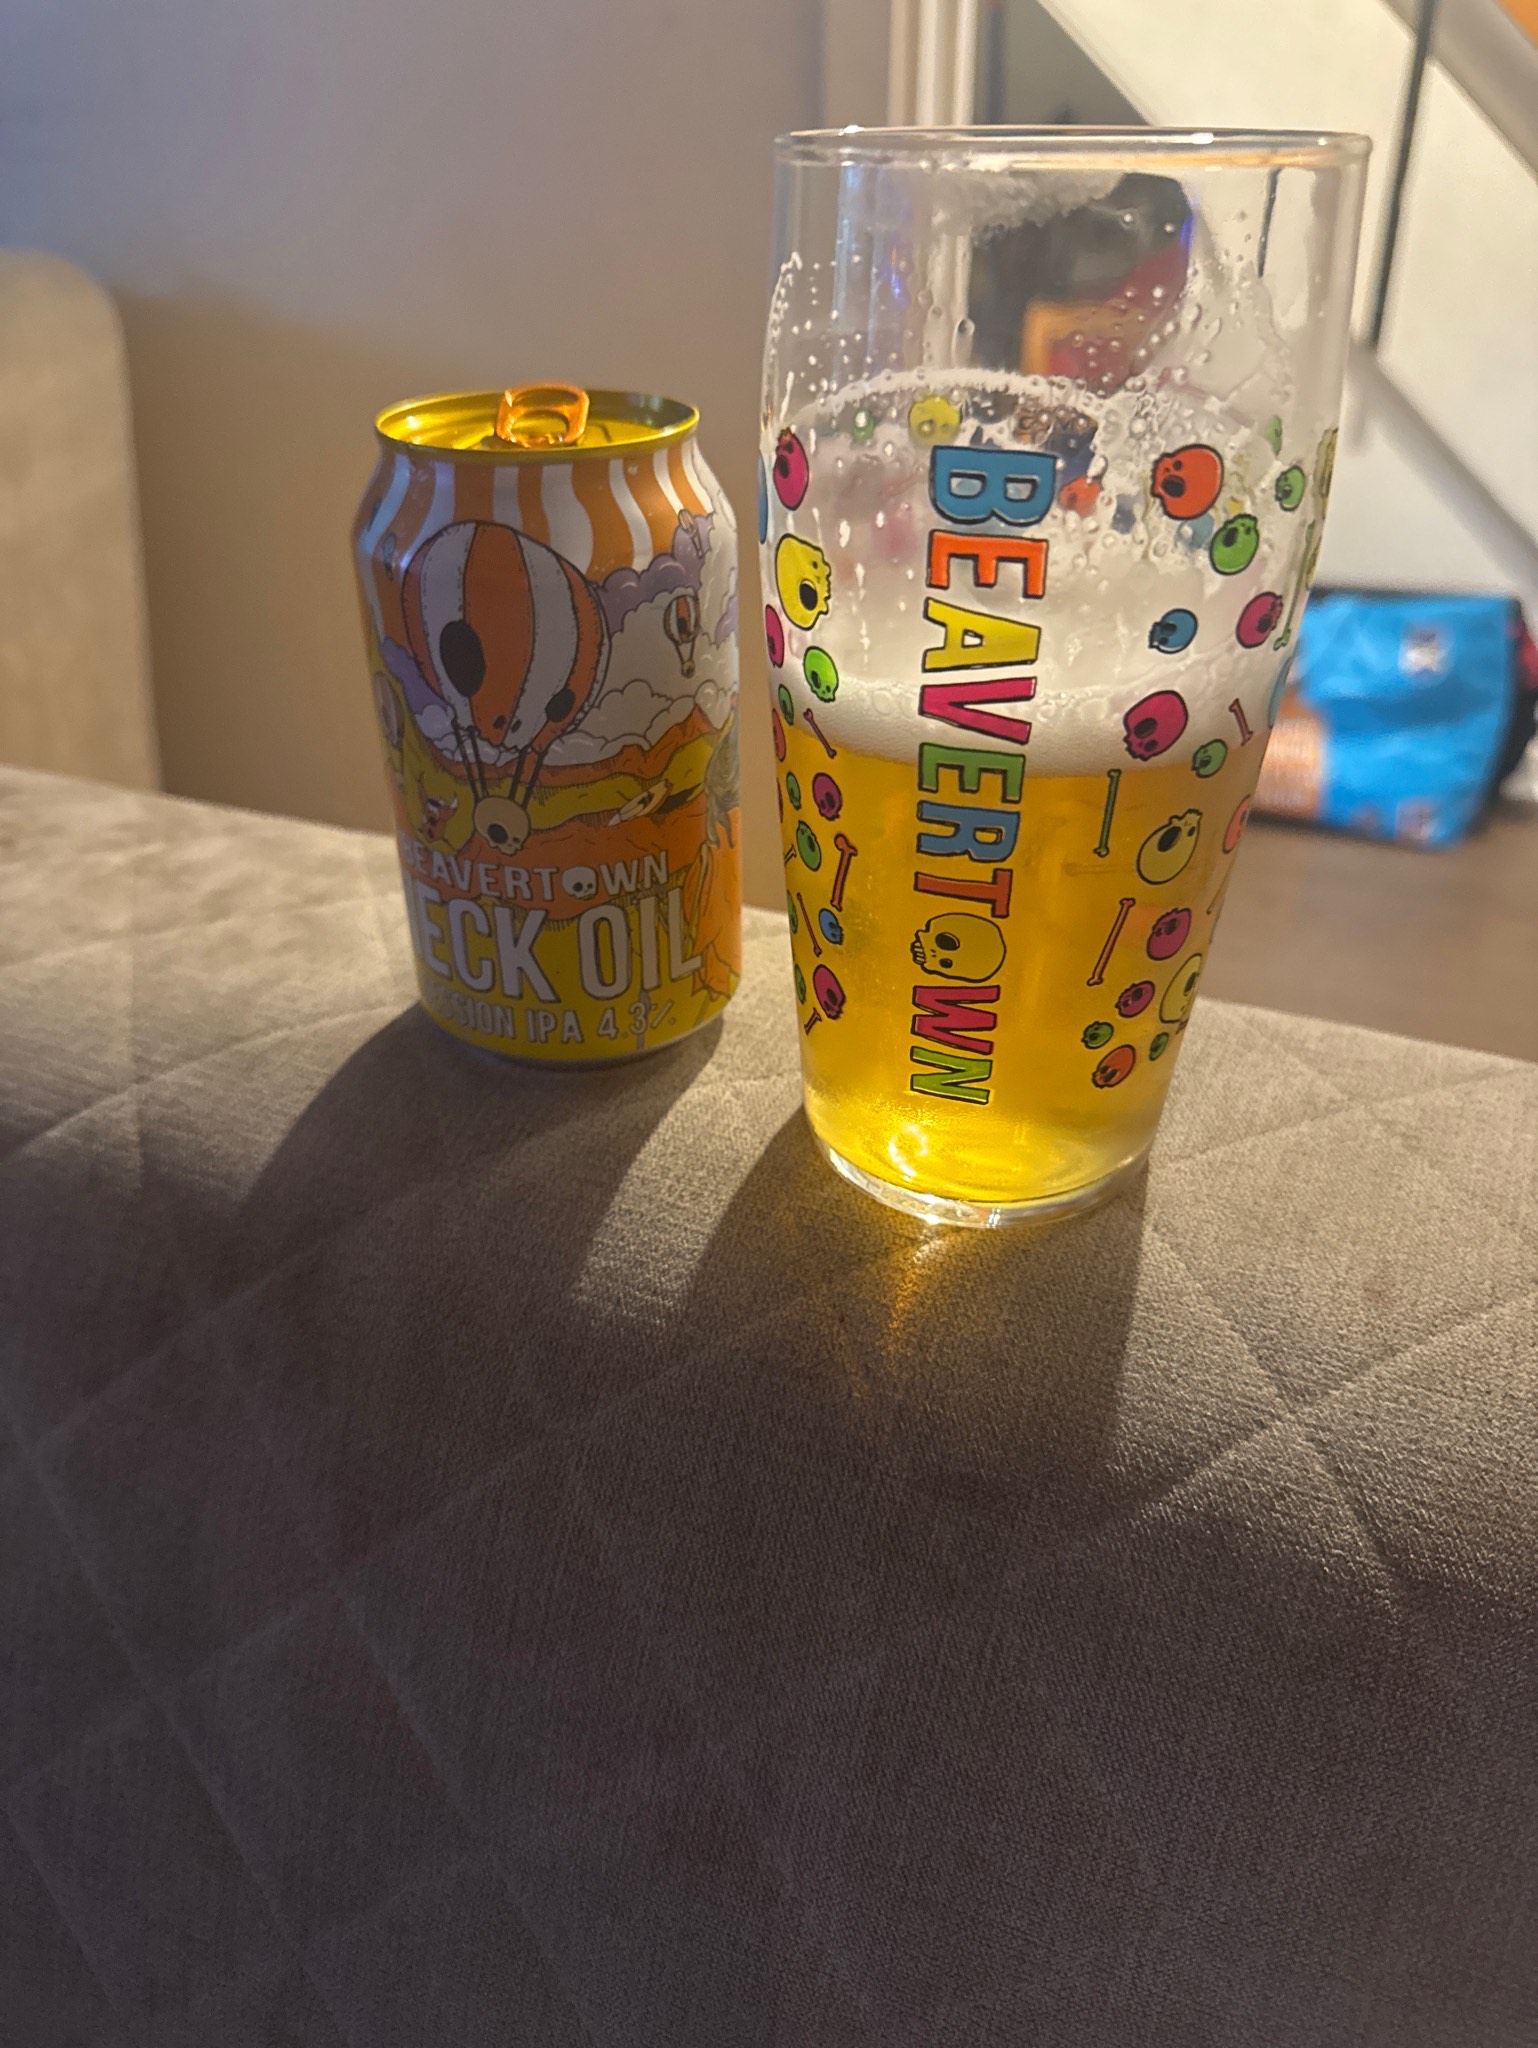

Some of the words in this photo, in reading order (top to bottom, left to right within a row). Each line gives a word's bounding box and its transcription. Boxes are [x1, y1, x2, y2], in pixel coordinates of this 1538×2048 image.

[406, 870, 561, 1004] ECK
[577, 887, 702, 1001] OIL
[428, 978, 516, 1040] SSION
[526, 1006, 584, 1044] IPA
